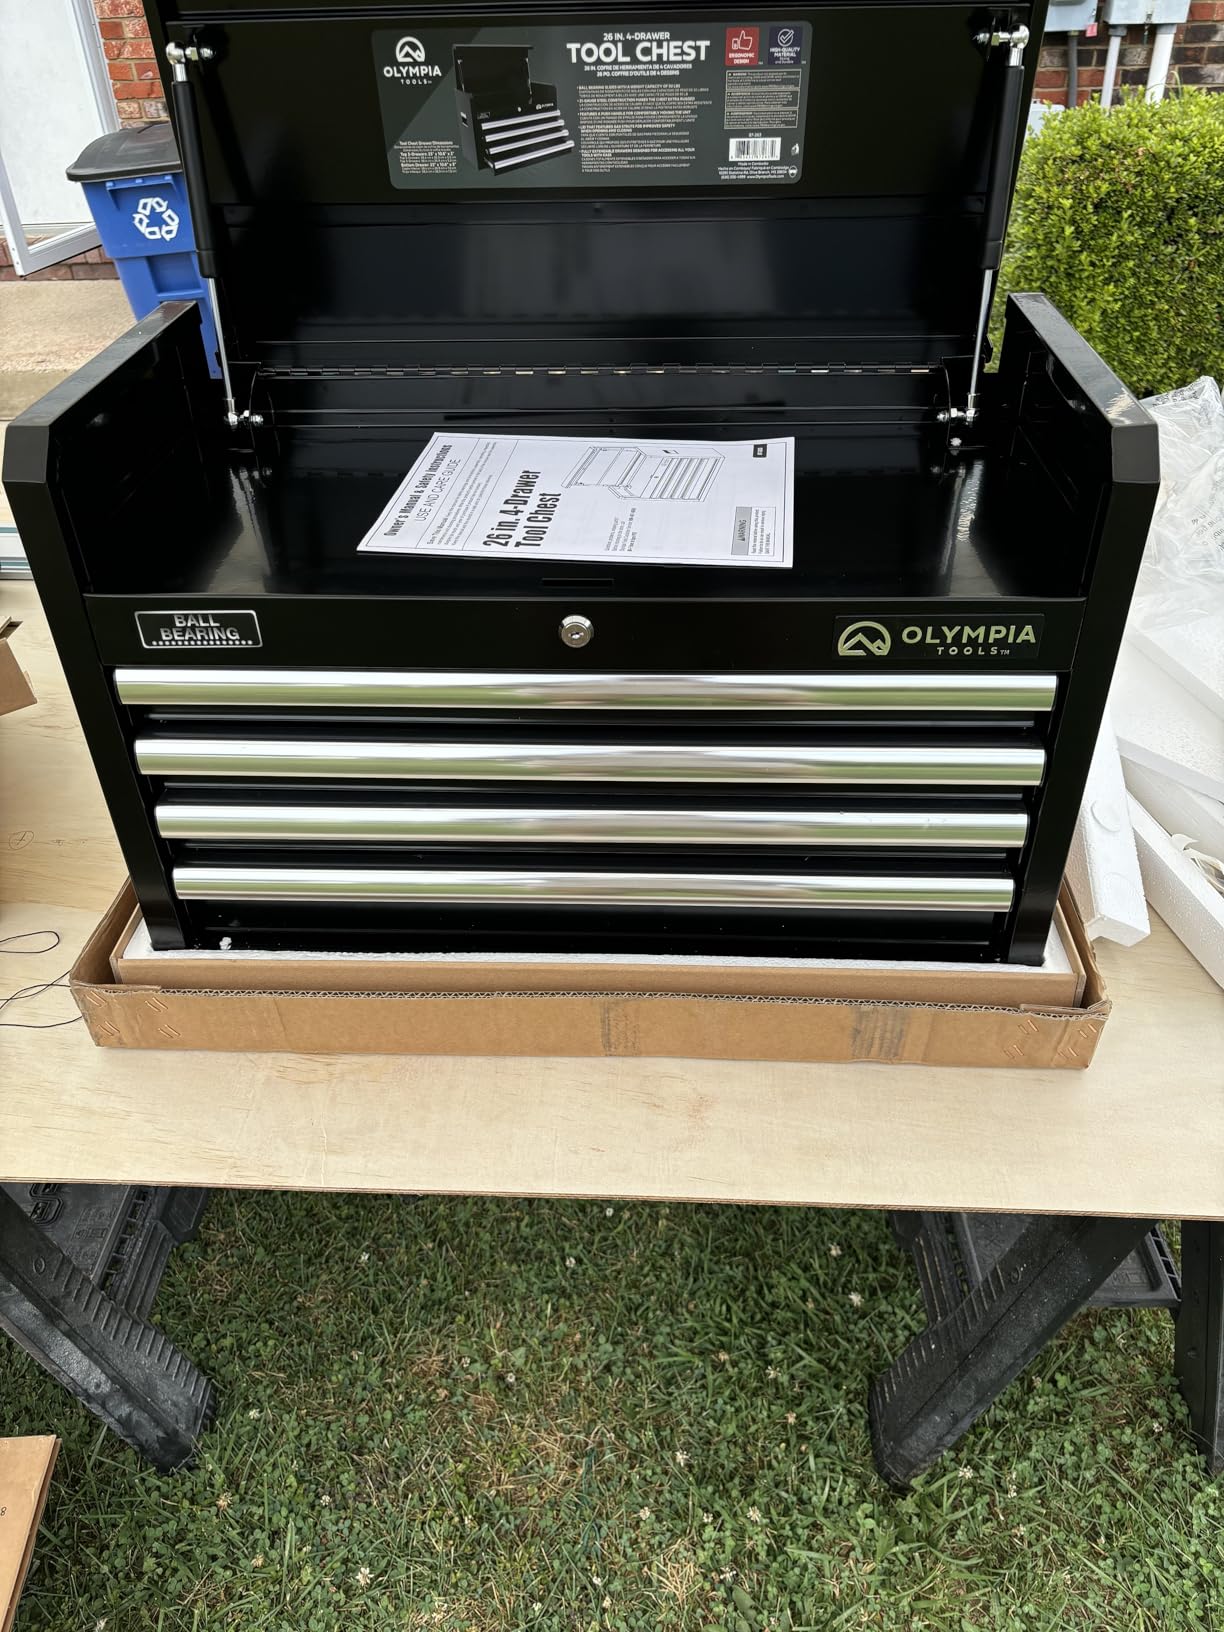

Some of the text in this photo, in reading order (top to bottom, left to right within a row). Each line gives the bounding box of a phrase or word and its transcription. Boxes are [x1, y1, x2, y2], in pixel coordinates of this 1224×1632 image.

[603, 31, 671, 41] 26 IN. 4-DRAWER
[566, 40, 711, 64] TOOL CHEST
[383, 65, 442, 78] OLYMPIA
[424, 444, 453, 474] Instructions
[414, 459, 461, 522] USE AND CARE GUIDE
[415, 473, 437, 490] Safety
[397, 494, 421, 514] Manual
[483, 470, 541, 547] 26 in. 4-Drawer
[383, 514, 408, 537] Owner's
[514, 492, 561, 548] Tool Chest
[173, 614, 221, 627] BALL
[160, 627, 241, 641] BEARING
[901, 625, 1036, 644] OLYMPIA
[936, 646, 999, 656] TOOLS
